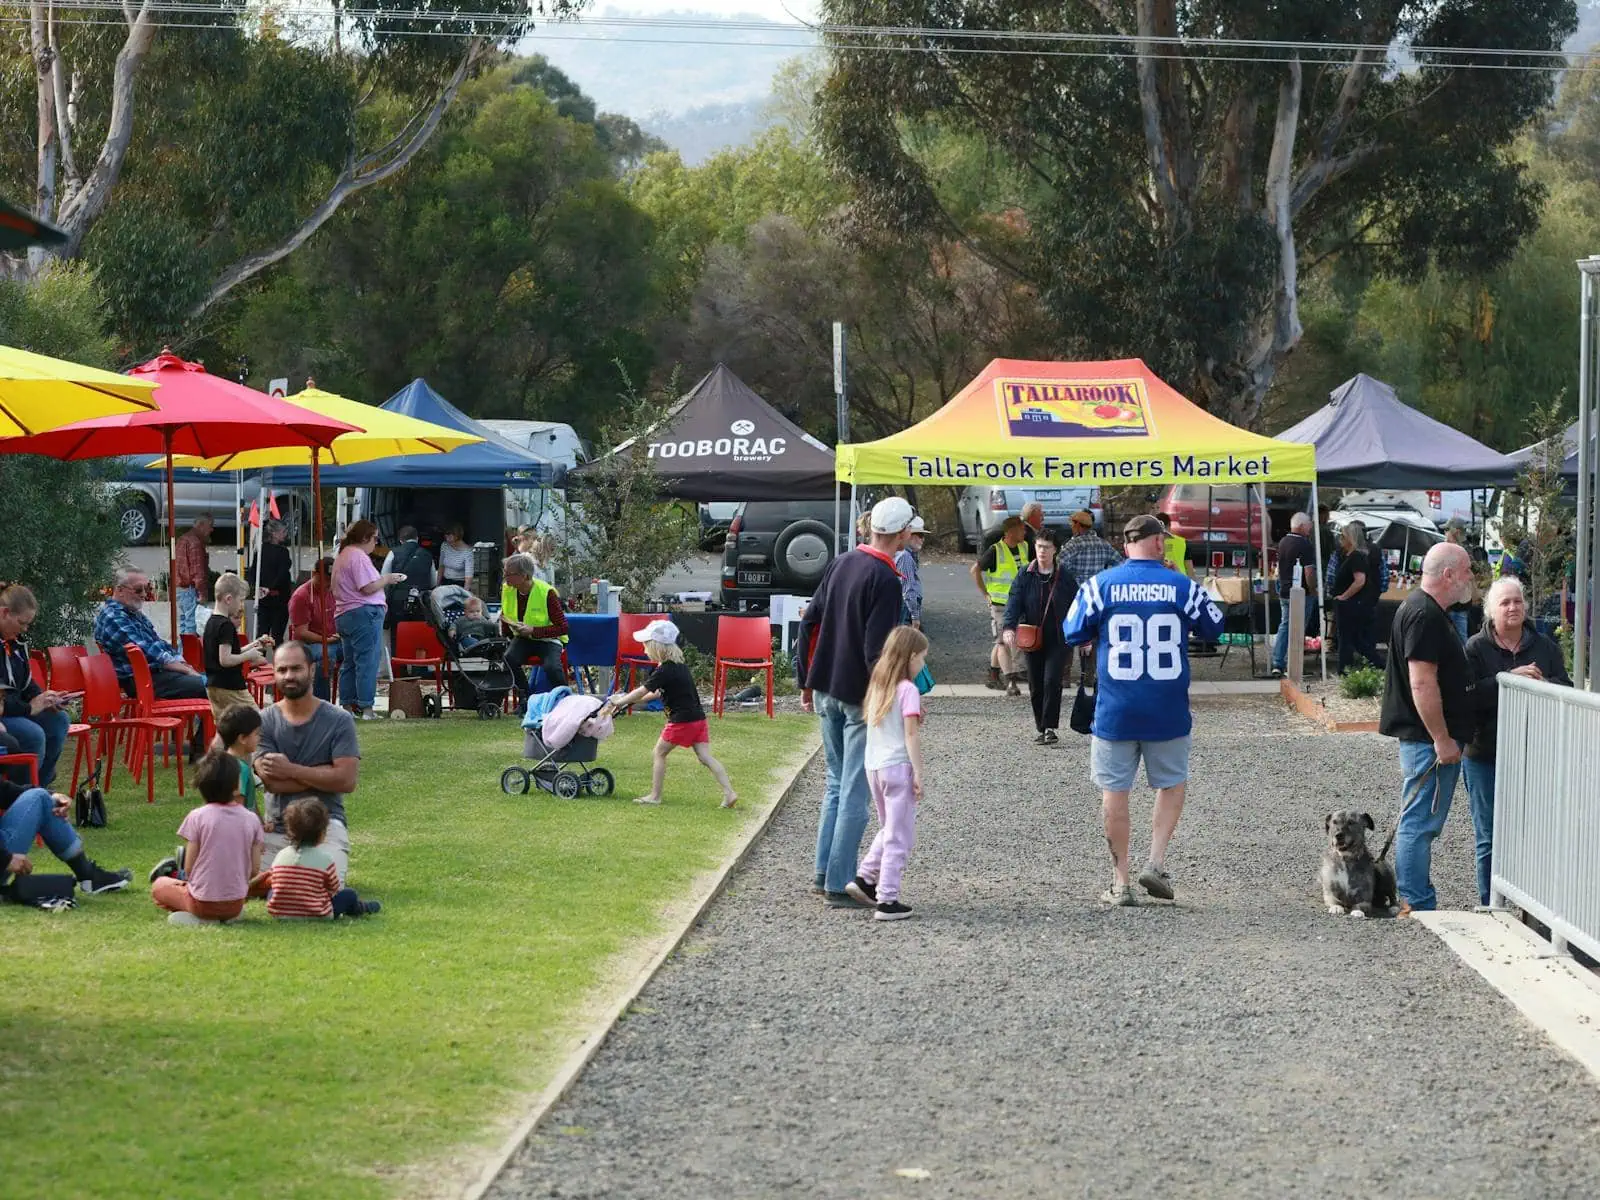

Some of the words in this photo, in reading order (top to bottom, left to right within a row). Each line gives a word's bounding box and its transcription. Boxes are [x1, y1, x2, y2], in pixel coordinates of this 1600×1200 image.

[1007, 384, 1137, 405] TALLAROOK
[647, 438, 786, 458] TOOBORAC
[902, 456, 1034, 478] Tallarook
[1045, 456, 1163, 478] Farmers
[1173, 455, 1270, 477] Market
[1111, 583, 1177, 603] HARRISON
[1108, 613, 1182, 681] 88
